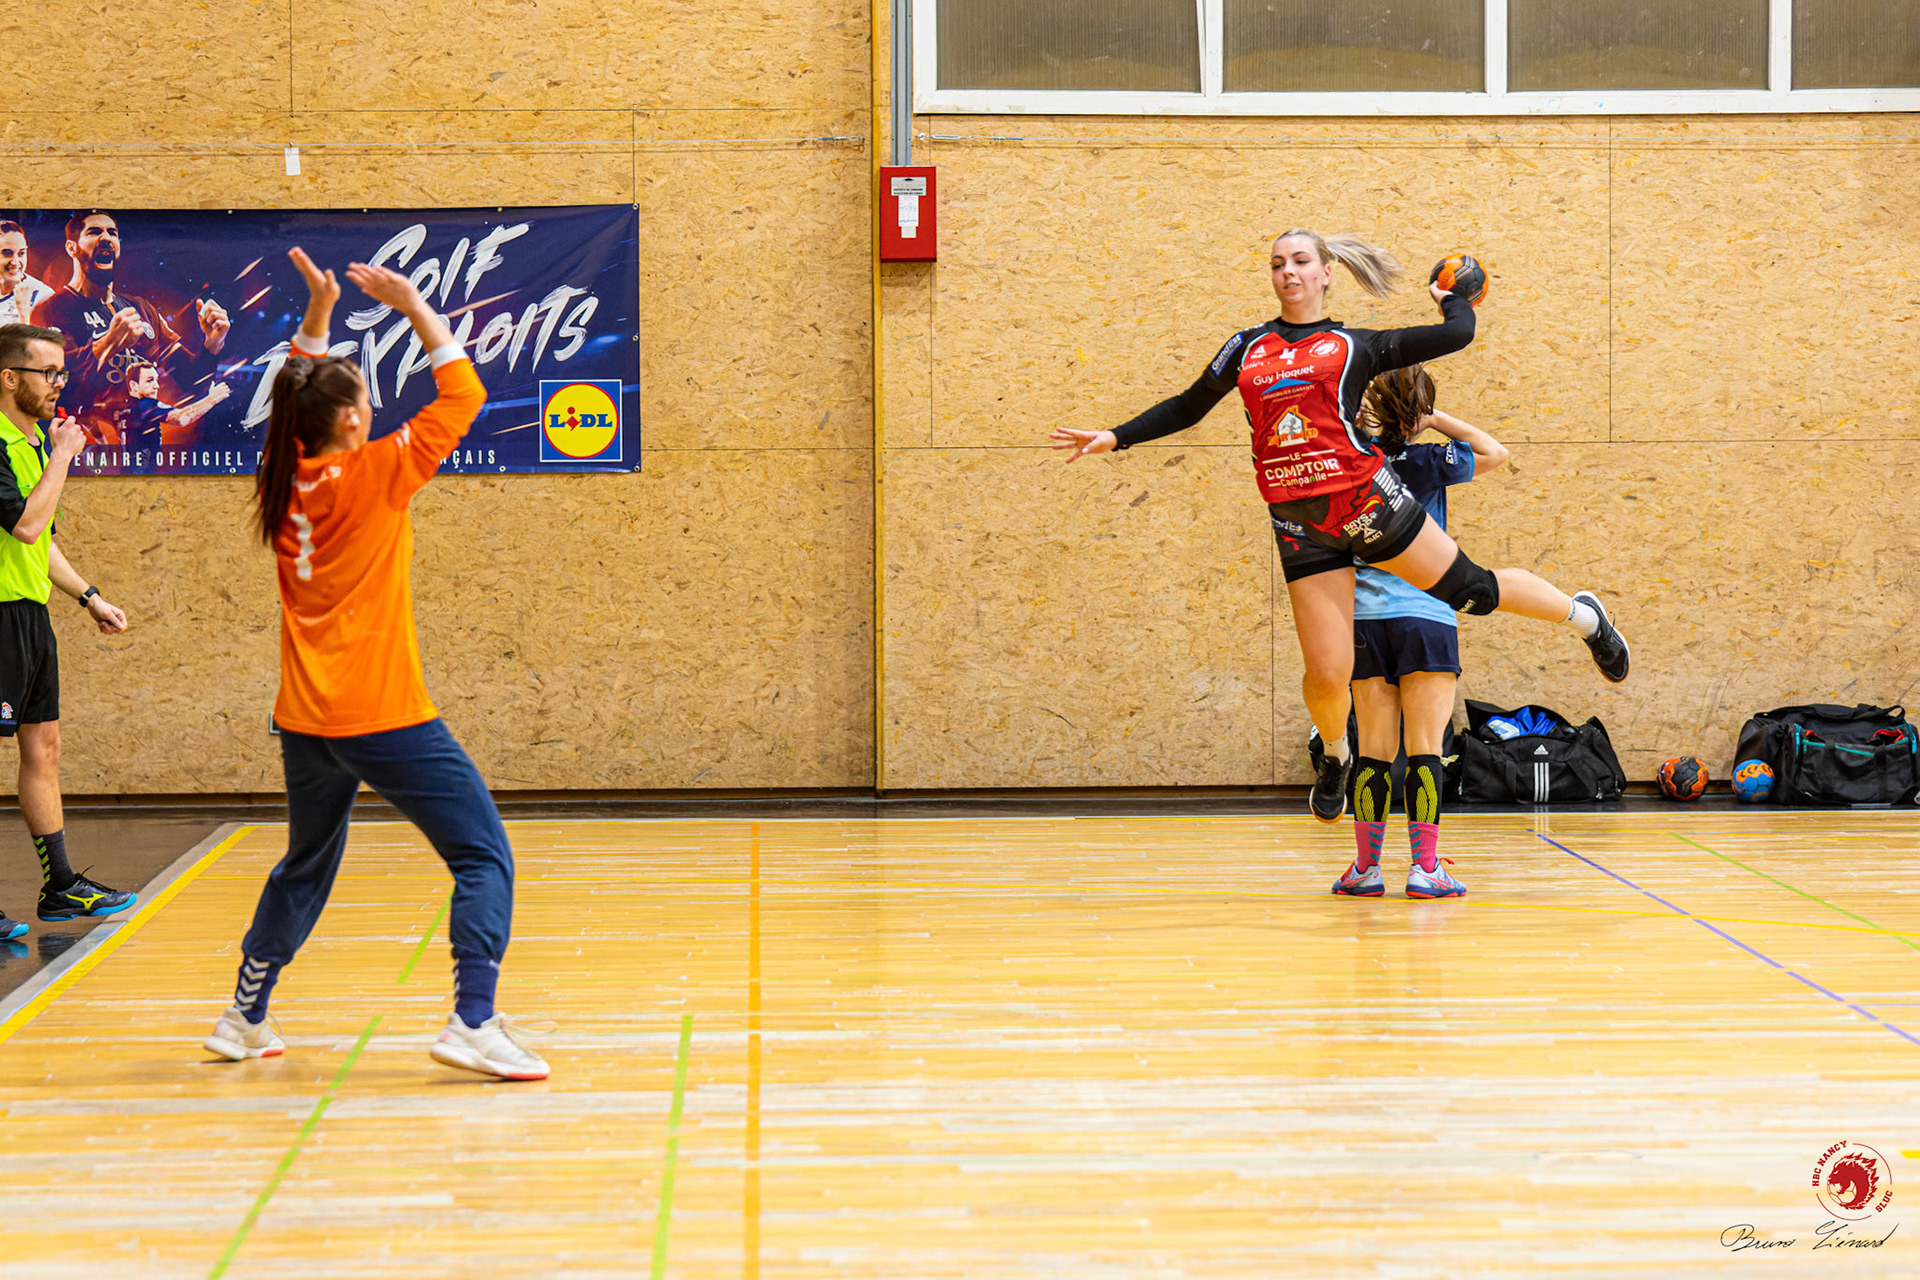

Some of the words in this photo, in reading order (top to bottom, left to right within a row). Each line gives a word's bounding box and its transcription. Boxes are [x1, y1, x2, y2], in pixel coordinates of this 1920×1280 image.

[1253, 375, 1274, 386] Guy
[1276, 365, 1315, 380] Hoquet
[74, 451, 143, 467] ENAIRE
[156, 451, 243, 467] OFFICIEL
[1289, 452, 1301, 461] LE
[1265, 458, 1340, 480] COMPTOIR
[1280, 471, 1327, 487] Campanile
